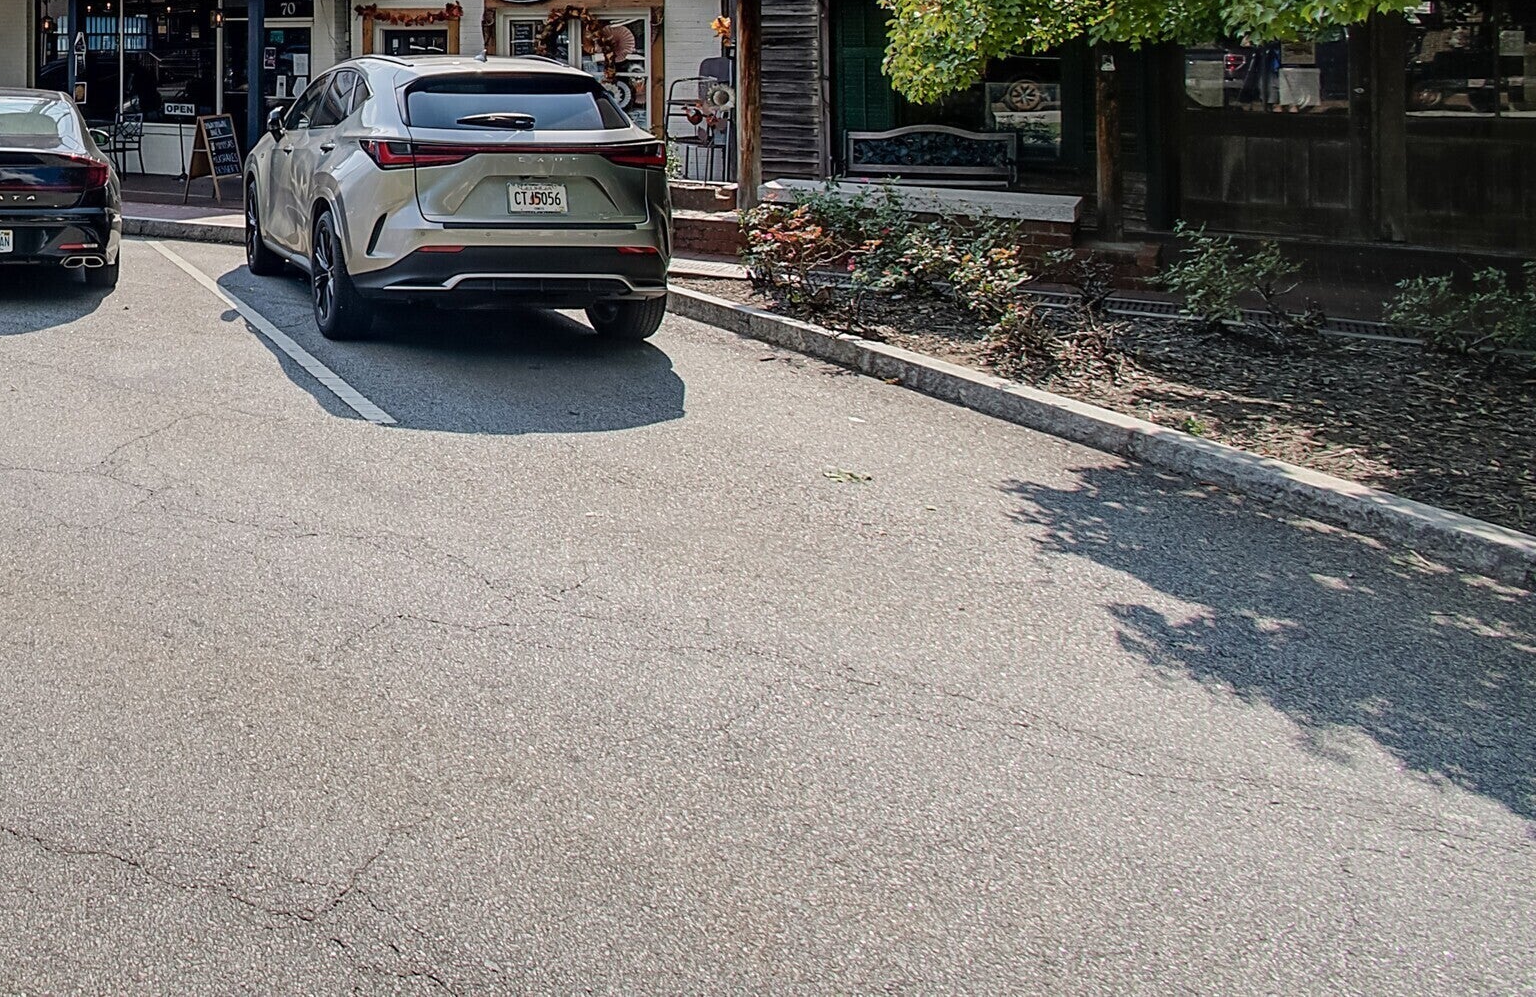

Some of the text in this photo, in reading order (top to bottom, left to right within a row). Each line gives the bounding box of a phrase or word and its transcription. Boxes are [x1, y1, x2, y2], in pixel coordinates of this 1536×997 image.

[280, 2, 296, 16] 70
[166, 104, 194, 114] OPEN
[514, 191, 562, 206] CTJ5056
